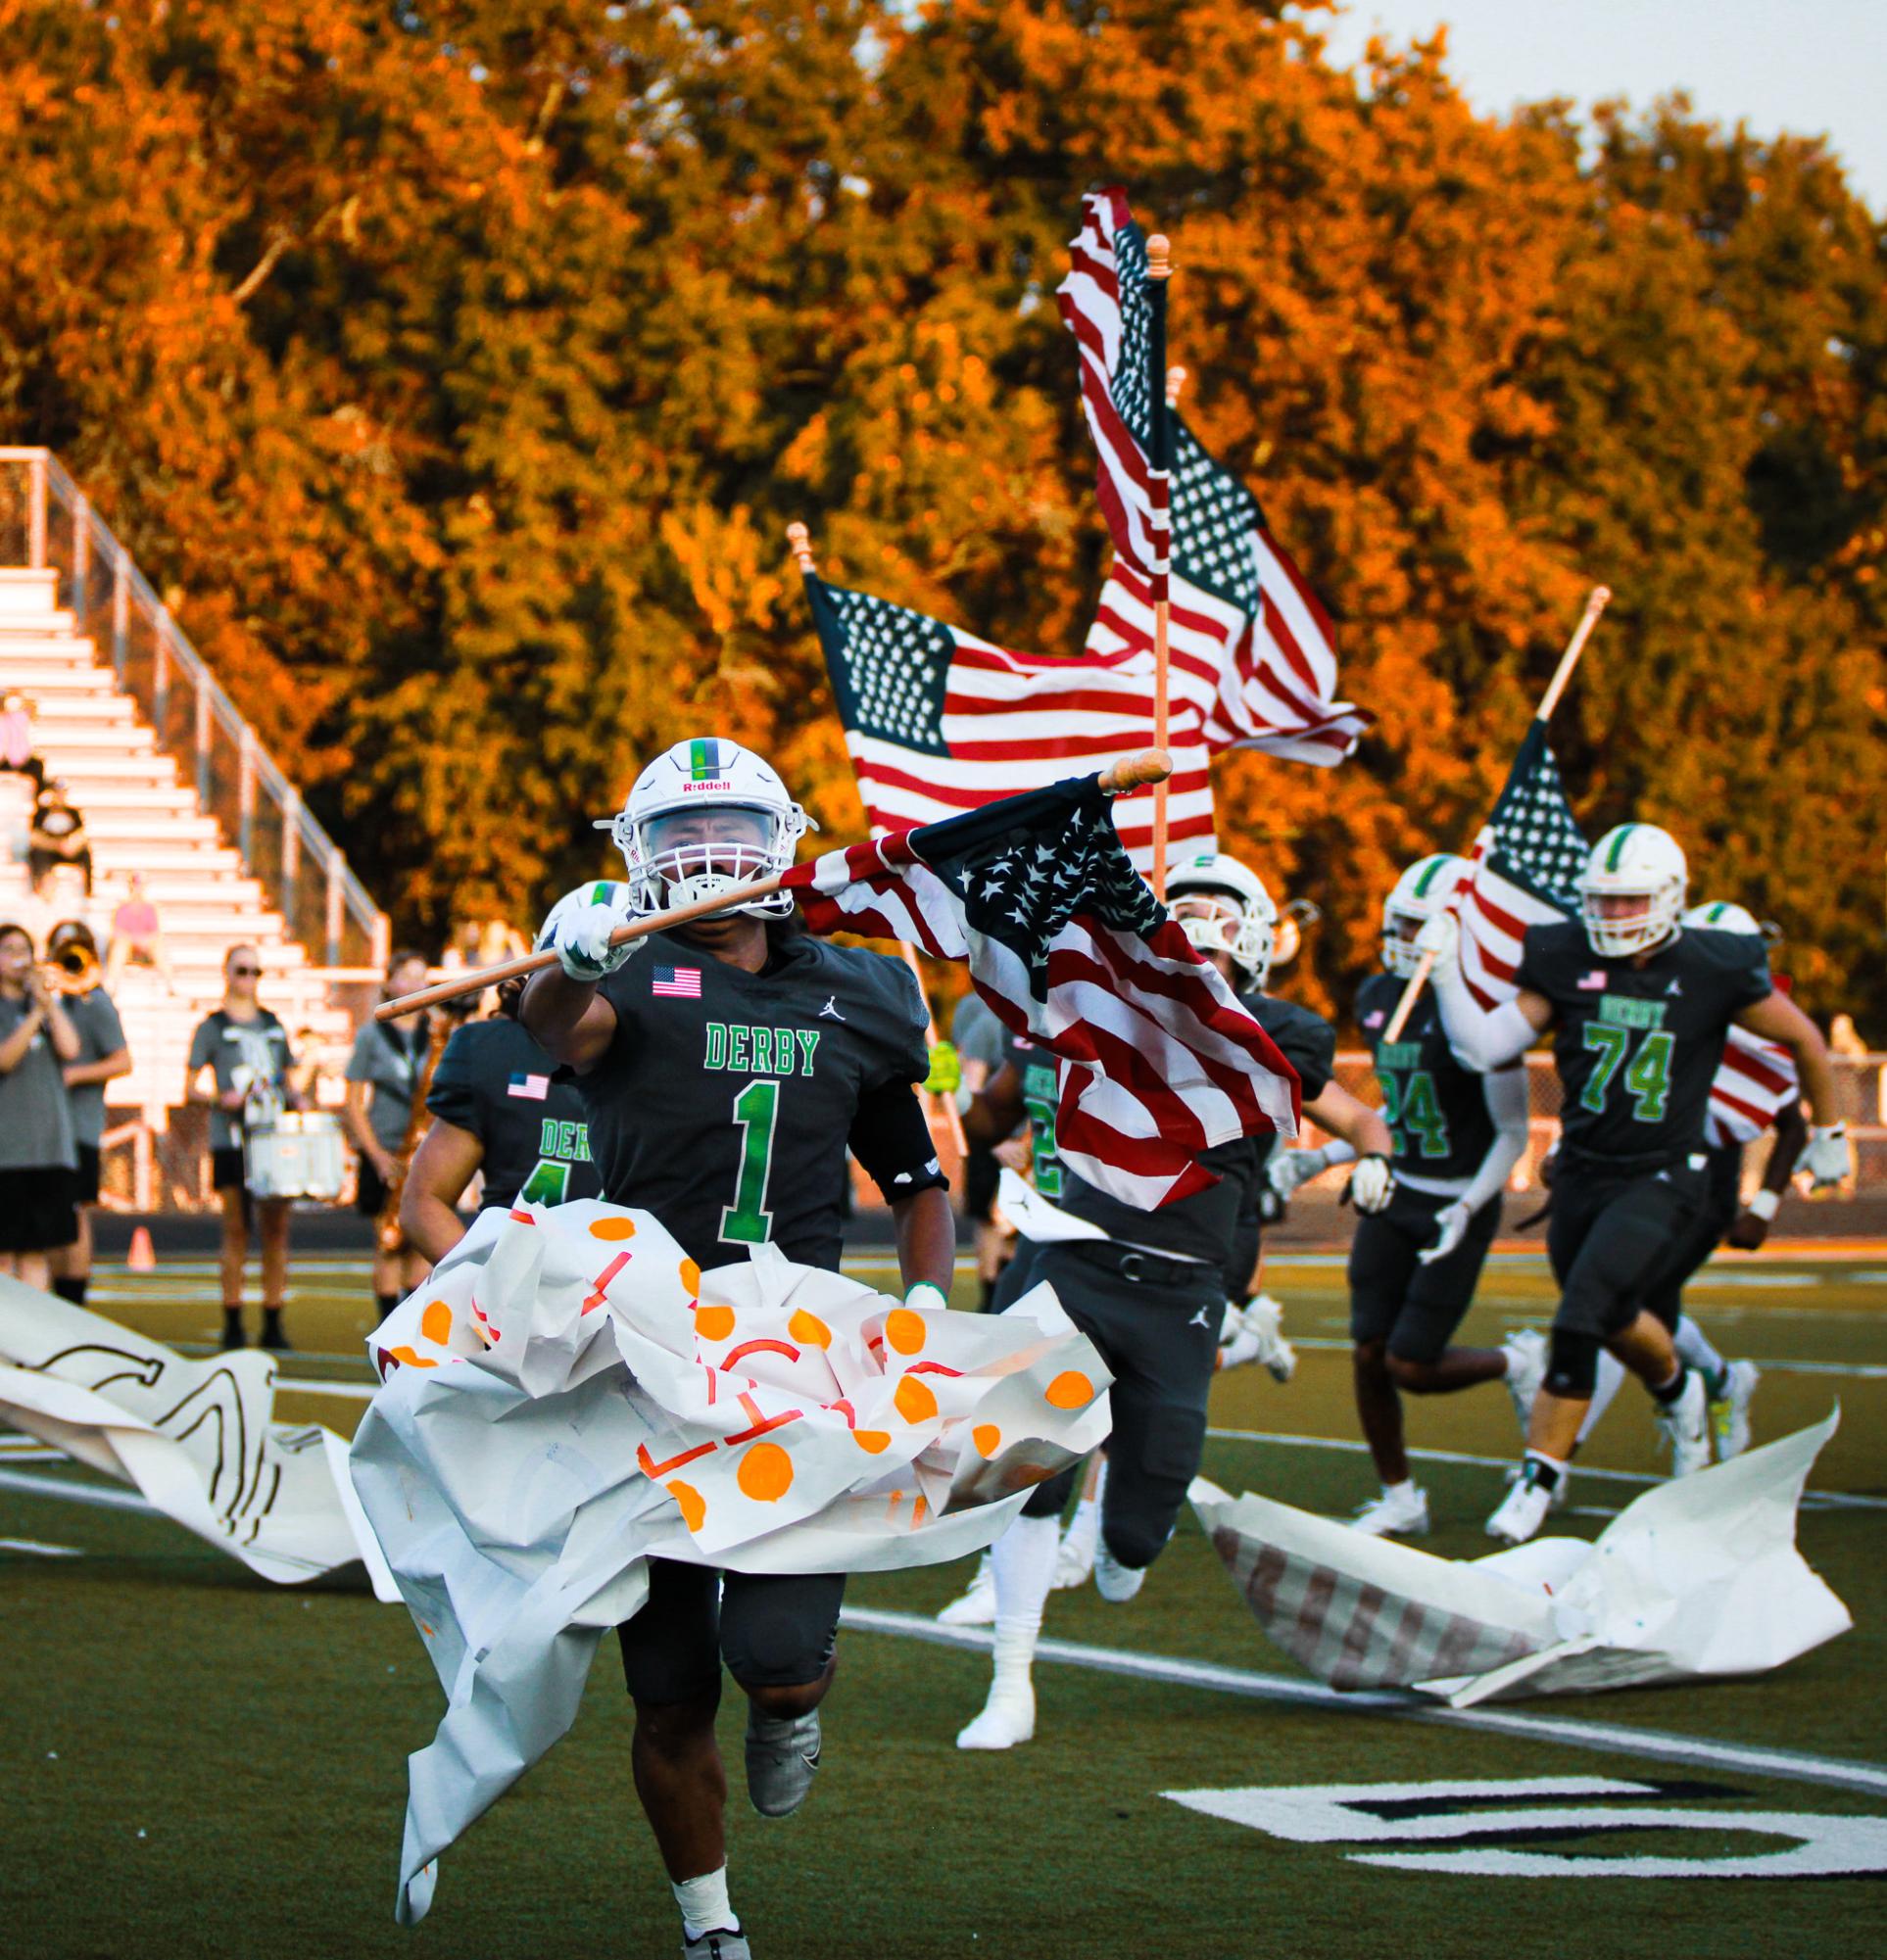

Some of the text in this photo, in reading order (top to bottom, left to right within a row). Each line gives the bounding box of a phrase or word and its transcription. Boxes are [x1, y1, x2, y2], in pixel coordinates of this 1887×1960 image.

[683, 781, 731, 792] Riddell
[703, 1022, 821, 1076] DERBY
[1580, 1020, 1676, 1123] 74
[717, 1078, 781, 1245] 1
